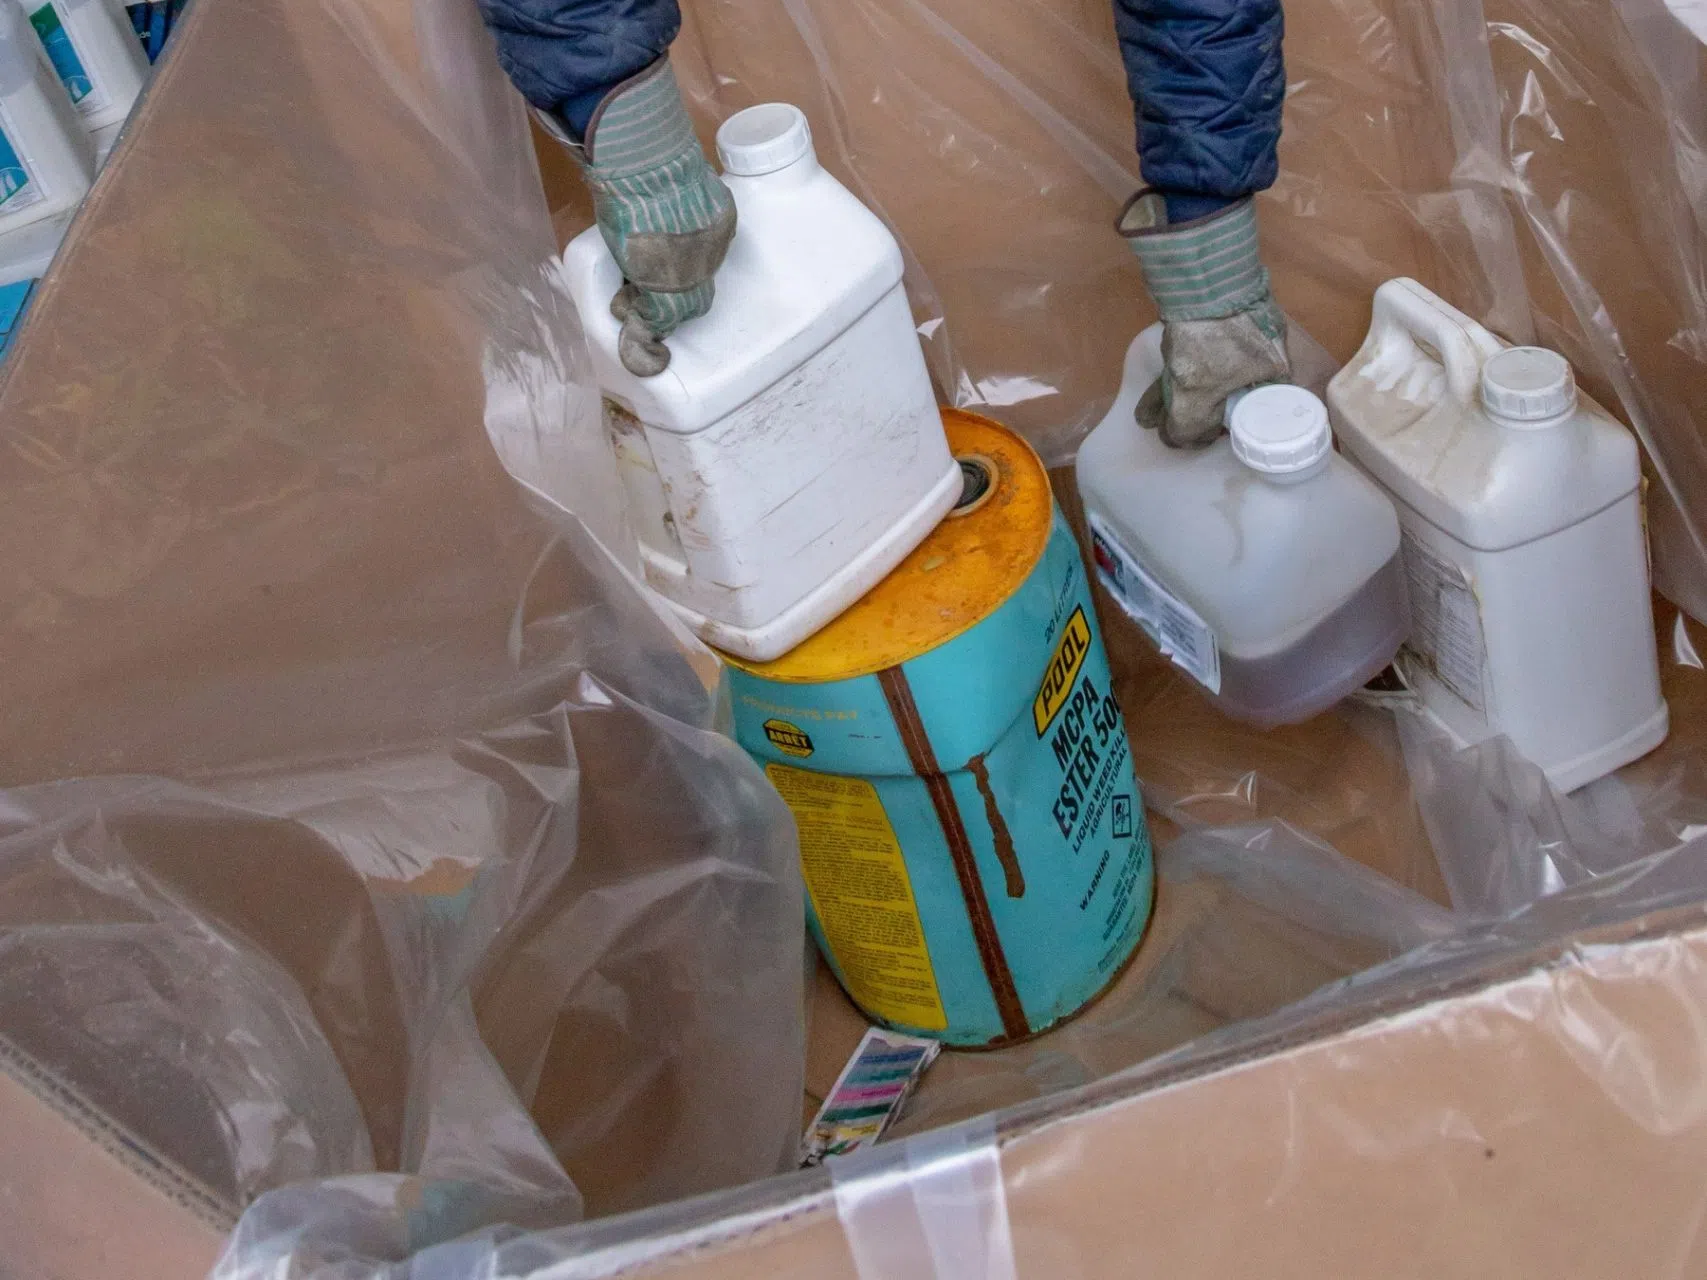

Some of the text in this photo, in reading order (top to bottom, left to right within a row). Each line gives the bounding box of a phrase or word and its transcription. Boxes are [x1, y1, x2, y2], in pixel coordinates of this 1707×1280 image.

[1041, 624, 1086, 717] POOL
[1051, 675, 1100, 772] MCPA
[1052, 734, 1100, 840] ESTER
[1072, 801, 1096, 857] LIQUID
[1092, 756, 1113, 801] WEED
[1090, 748, 1128, 839] AGRICULTURAL
[1079, 849, 1111, 911] WARNING
